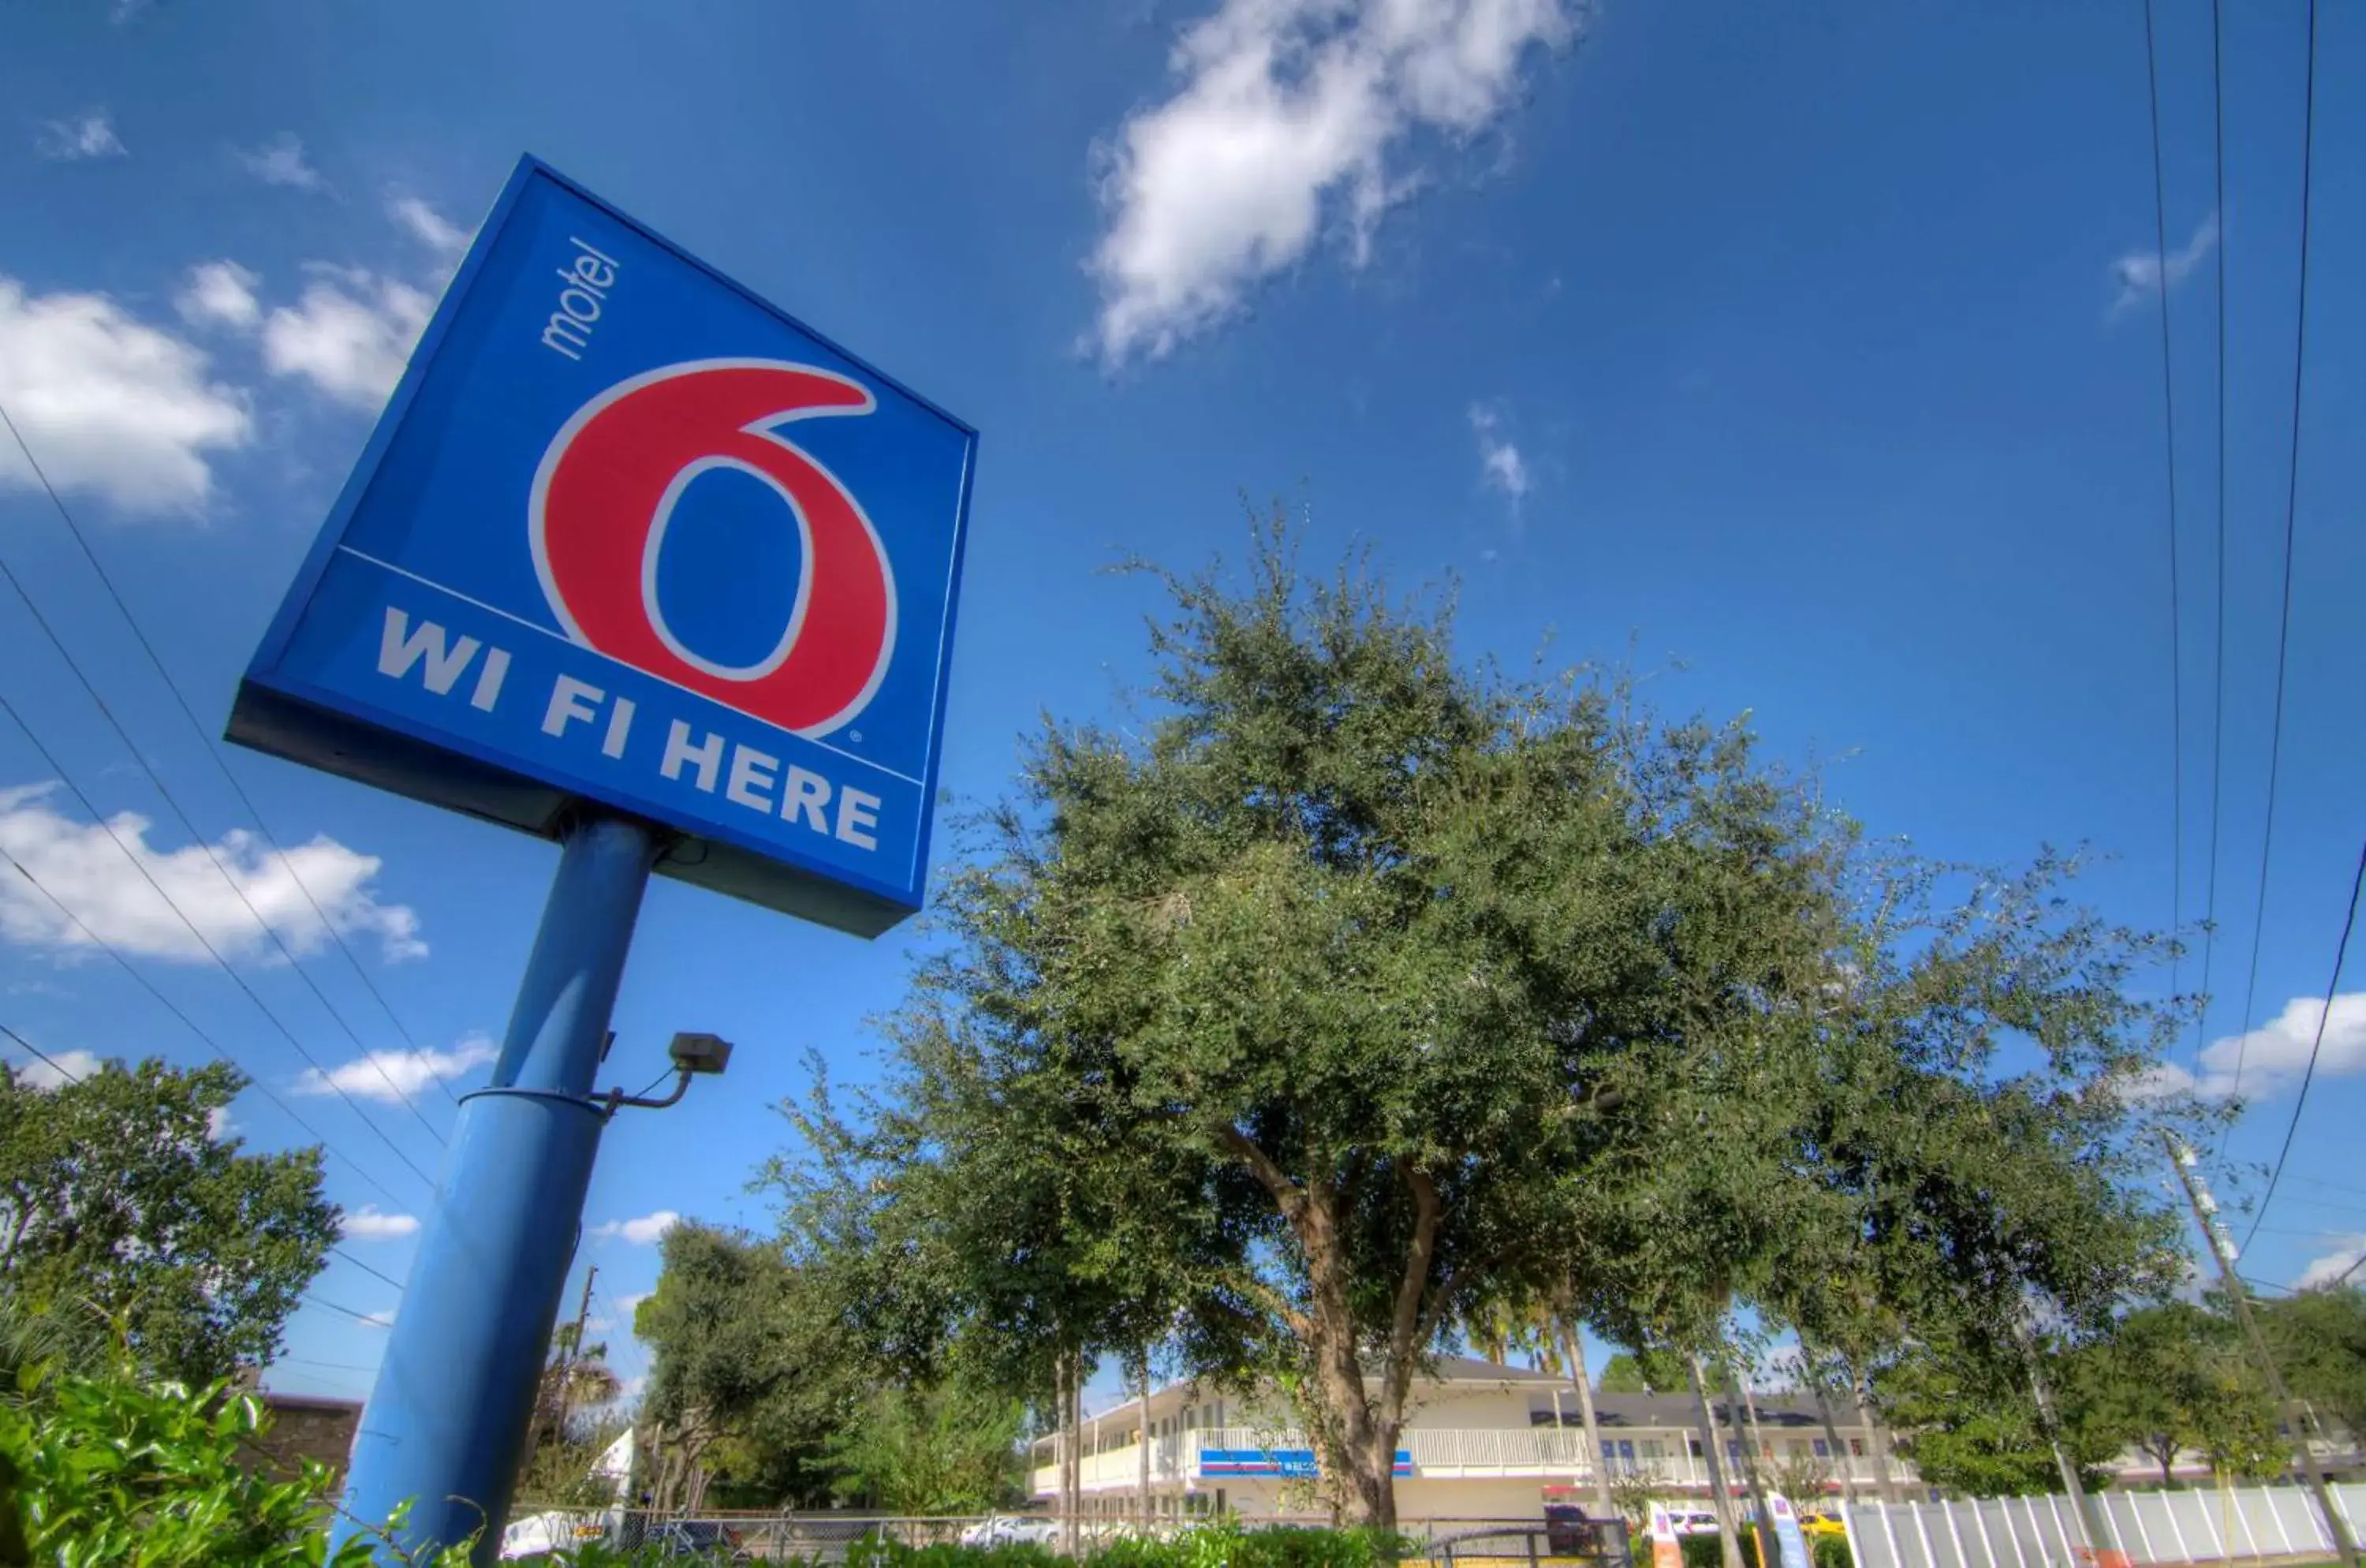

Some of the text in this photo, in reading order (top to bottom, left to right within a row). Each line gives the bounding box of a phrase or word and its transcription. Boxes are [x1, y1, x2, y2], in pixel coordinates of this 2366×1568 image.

[541, 236, 620, 360] motel
[528, 357, 898, 741] 6
[377, 606, 883, 851] WI FI HERE
